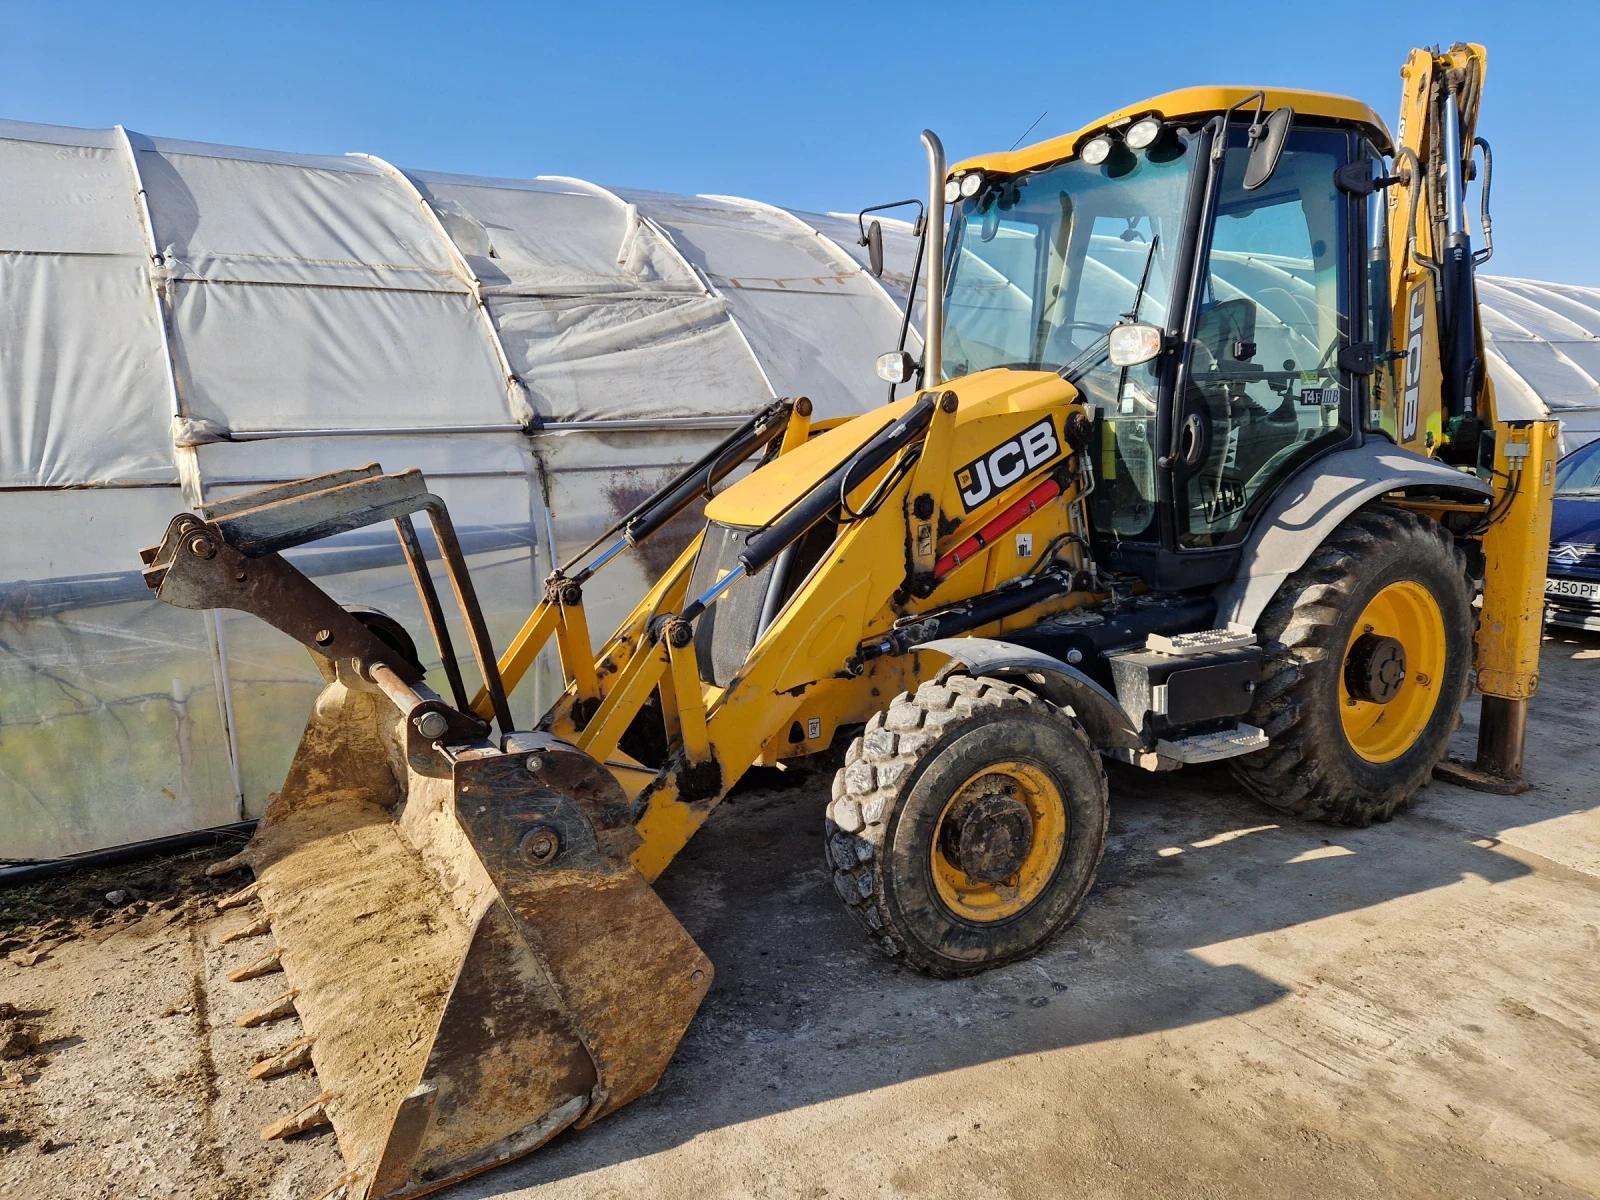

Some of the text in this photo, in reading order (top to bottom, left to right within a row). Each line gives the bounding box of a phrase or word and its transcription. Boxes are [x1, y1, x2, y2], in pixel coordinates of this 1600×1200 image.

[1403, 291, 1424, 440] JCB
[963, 421, 1058, 507] JCB
[1546, 580, 1578, 594] 2450
